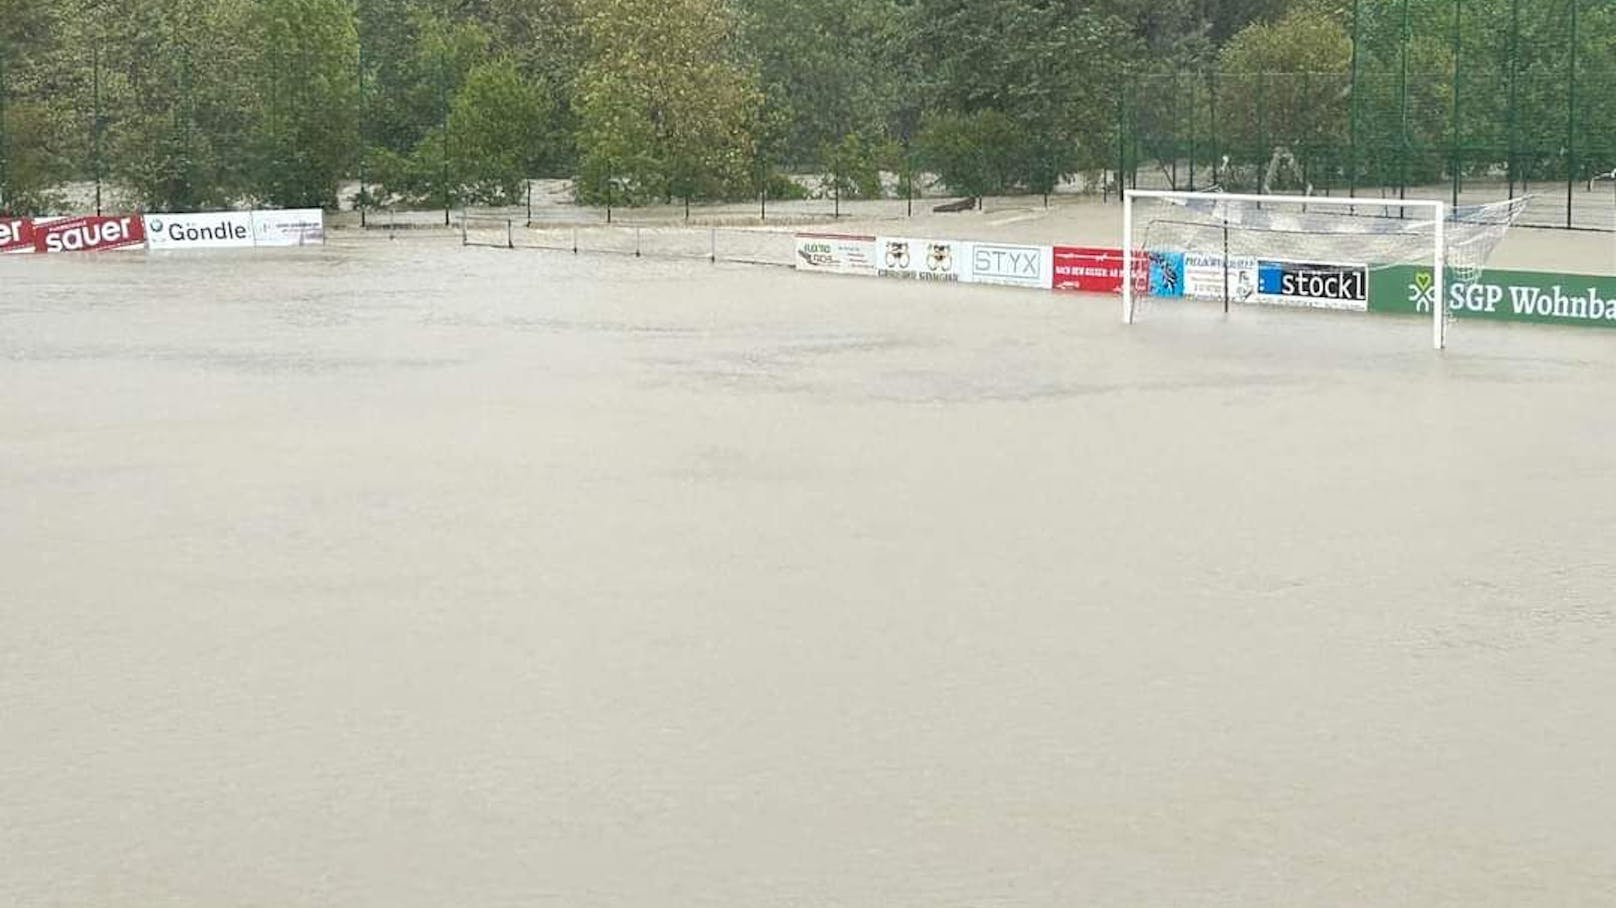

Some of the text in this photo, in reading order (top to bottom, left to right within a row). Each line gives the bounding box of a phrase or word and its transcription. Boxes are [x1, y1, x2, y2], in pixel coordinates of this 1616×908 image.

[46, 217, 131, 252] sauer
[168, 221, 247, 241] Göndle
[975, 250, 1037, 275] STYX
[1281, 269, 1366, 300] stöckl
[1449, 282, 1503, 312] SGP
